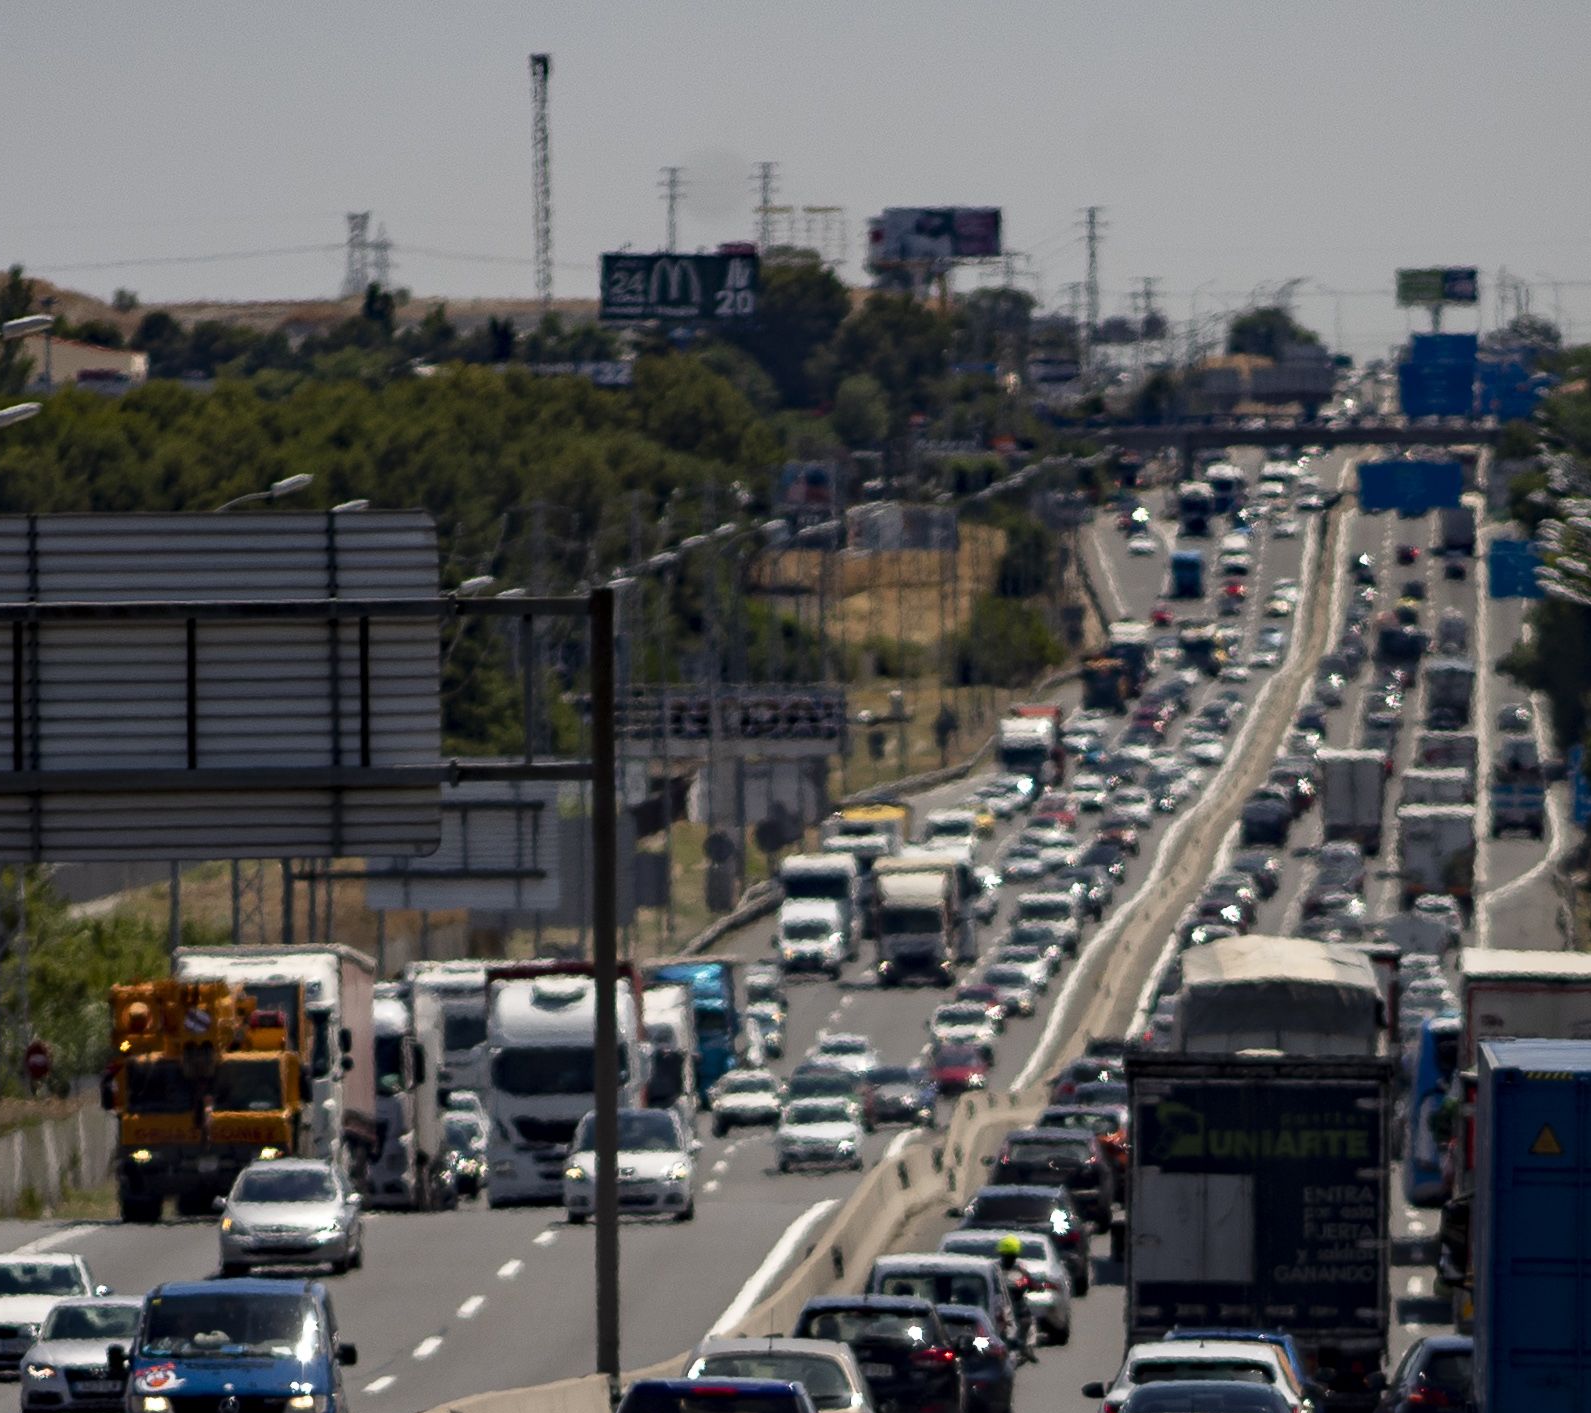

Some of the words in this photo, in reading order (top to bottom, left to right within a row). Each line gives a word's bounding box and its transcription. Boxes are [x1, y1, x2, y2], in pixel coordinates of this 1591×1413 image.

[714, 290, 755, 317] 20
[1209, 1129, 1370, 1159] UNIARTE
[1303, 1185, 1375, 1203] ENTRA
[1273, 1264, 1376, 1284] GANANDO
